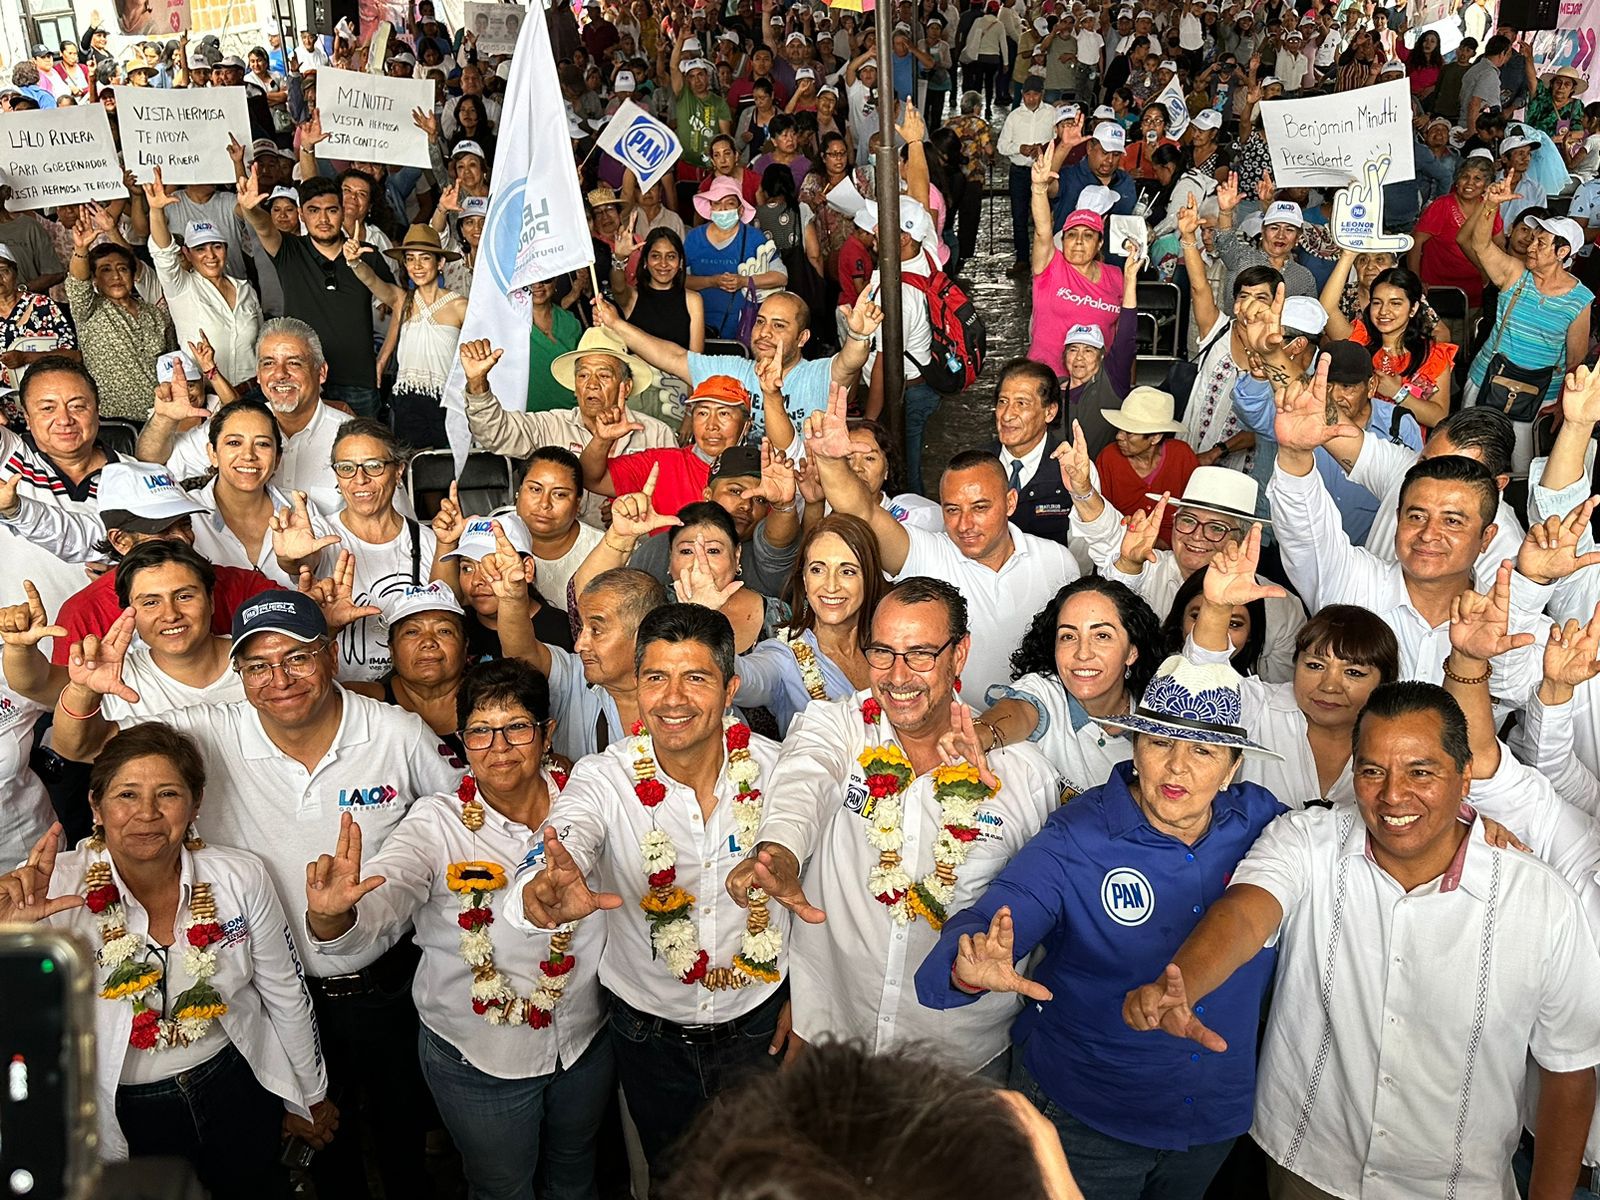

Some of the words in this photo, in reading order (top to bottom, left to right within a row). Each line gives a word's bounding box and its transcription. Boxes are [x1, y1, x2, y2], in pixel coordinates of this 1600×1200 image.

[338, 86, 394, 111] MINUTTI
[133, 105, 175, 121] VISTA
[177, 106, 225, 121] HERMOSA
[332, 112, 364, 127] VISTA
[369, 119, 400, 132] HERMOSA
[1282, 113, 1354, 147] Benjamin
[1357, 96, 1398, 132] Minutti
[8, 129, 45, 149] LALO
[48, 129, 95, 147] RIVERA
[135, 129, 152, 144] TE
[155, 130, 189, 144] APOYA
[327, 131, 351, 145] ESTA
[352, 135, 389, 149] CONTIGO
[627, 130, 664, 167] PAN
[1280, 145, 1354, 168] Presidente
[139, 150, 164, 166] LALO
[9, 161, 39, 177] PARA
[42, 159, 108, 174] GOBERNADOR
[42, 184, 82, 196] HERMOSA
[84, 182, 95, 191] TE
[96, 180, 122, 190] APOYA
[339, 787, 383, 805] LALO
[847, 791, 861, 806] PAN
[1111, 883, 1145, 909] PAN
